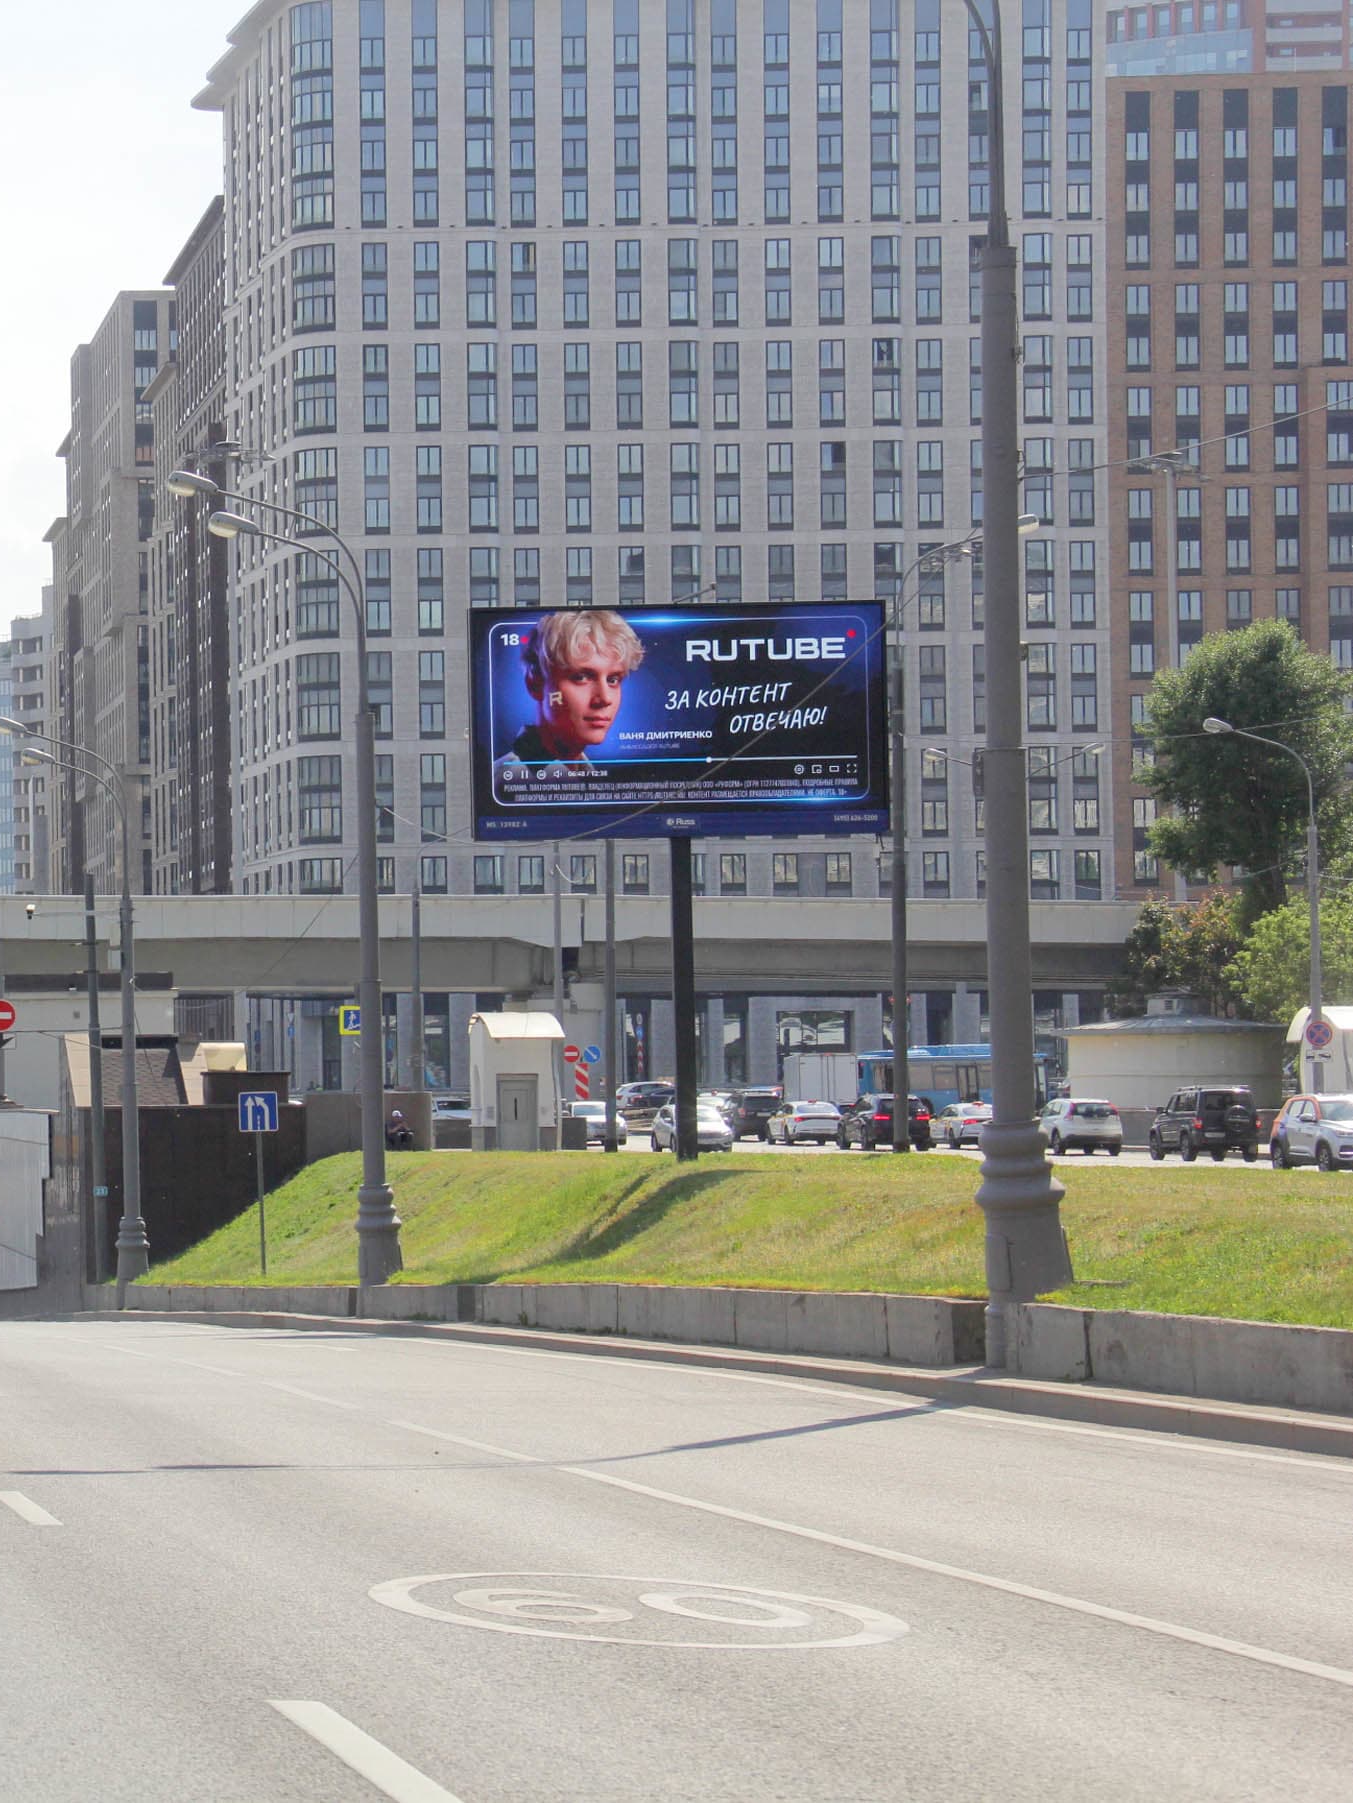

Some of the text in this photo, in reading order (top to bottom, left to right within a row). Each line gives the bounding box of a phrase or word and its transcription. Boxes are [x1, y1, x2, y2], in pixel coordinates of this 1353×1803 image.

[685, 637, 847, 662] RUTUBE
[664, 682, 793, 710] ЗА КОНТЕНТ
[729, 706, 828, 734] ОТВЕЧАЮ!
[619, 730, 713, 741] ВАНЯ ДМИТРИЕНКО
